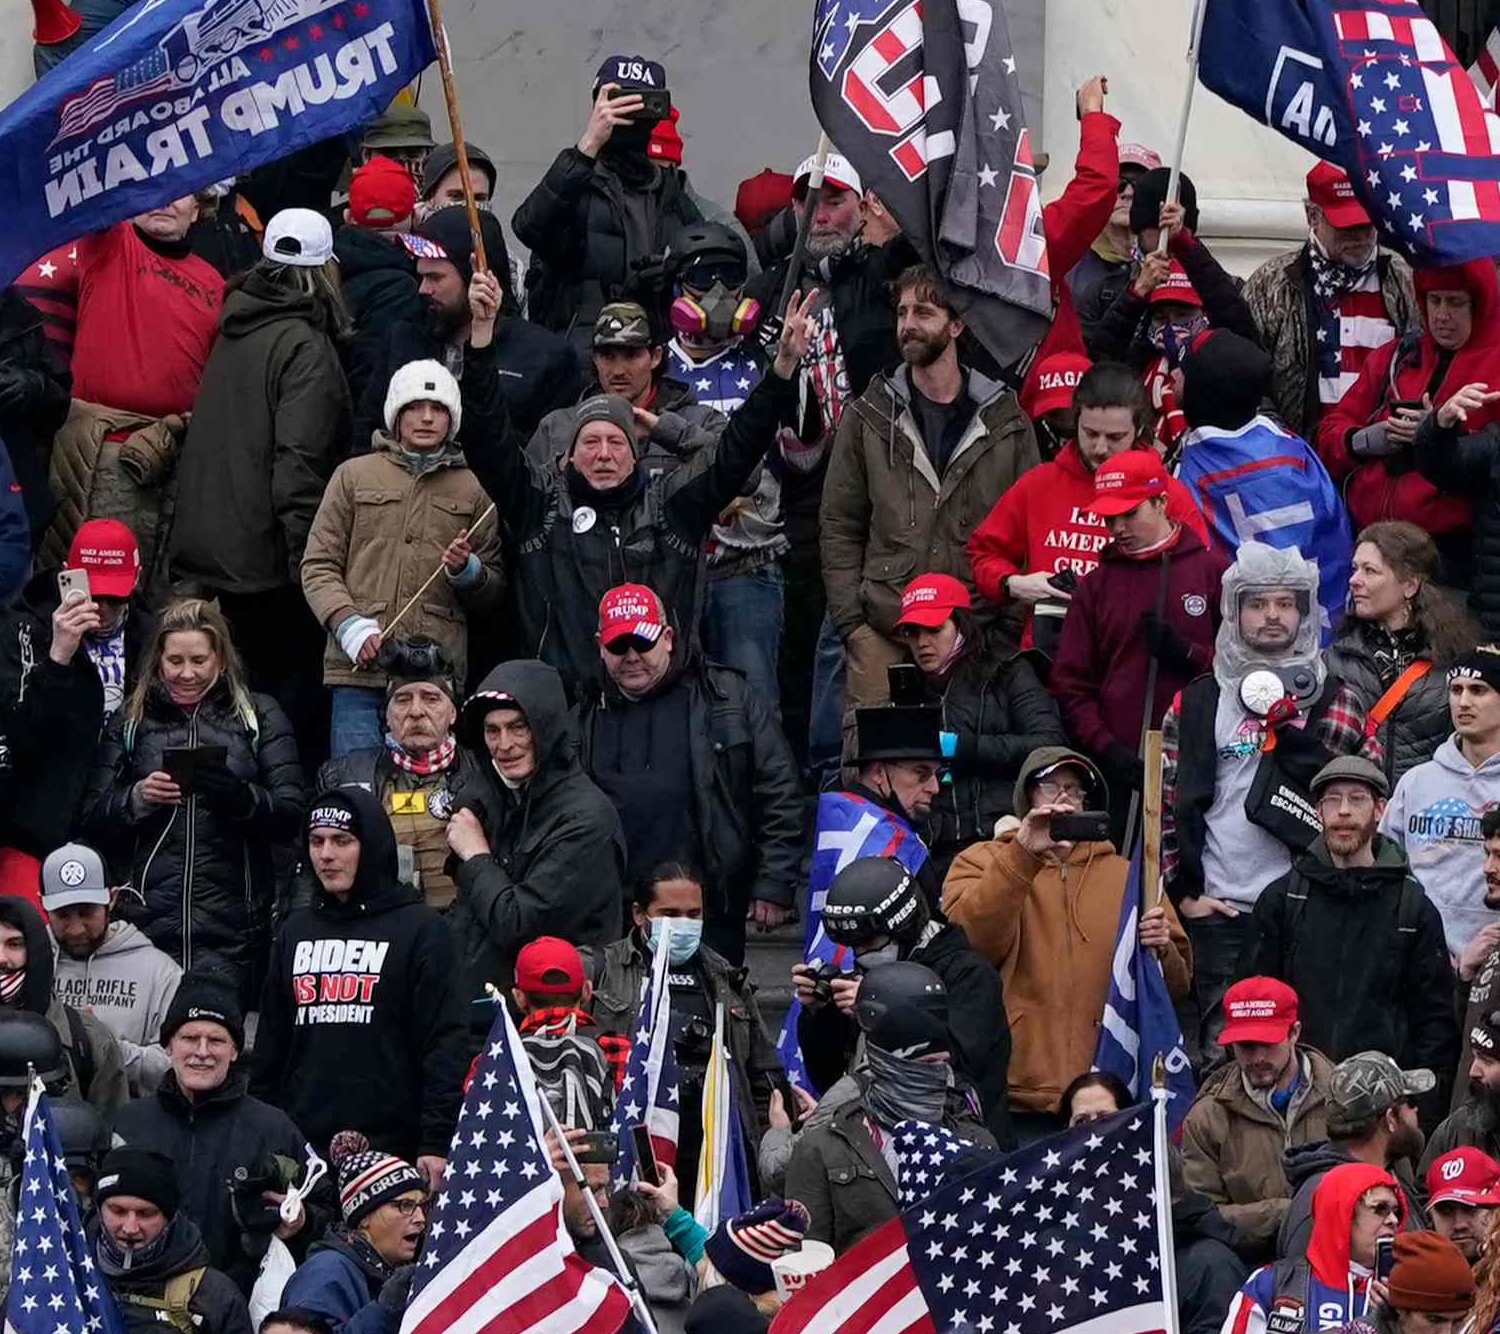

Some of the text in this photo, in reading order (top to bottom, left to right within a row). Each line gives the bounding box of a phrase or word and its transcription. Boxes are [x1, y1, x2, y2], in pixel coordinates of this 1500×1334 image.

[616, 62, 655, 87] USA
[1040, 372, 1084, 390] MAGA
[607, 605, 649, 620] TRUMP
[310, 809, 352, 824] TRUMP
[1403, 814, 1431, 835] OUT
[887, 896, 918, 929] PRESS
[294, 940, 389, 975] BIDEN
[95, 979, 138, 1000] RIFLE
[319, 973, 380, 1005] NOT
[308, 1005, 375, 1025] PRESIDENT
[1441, 1156, 1464, 1180] W
